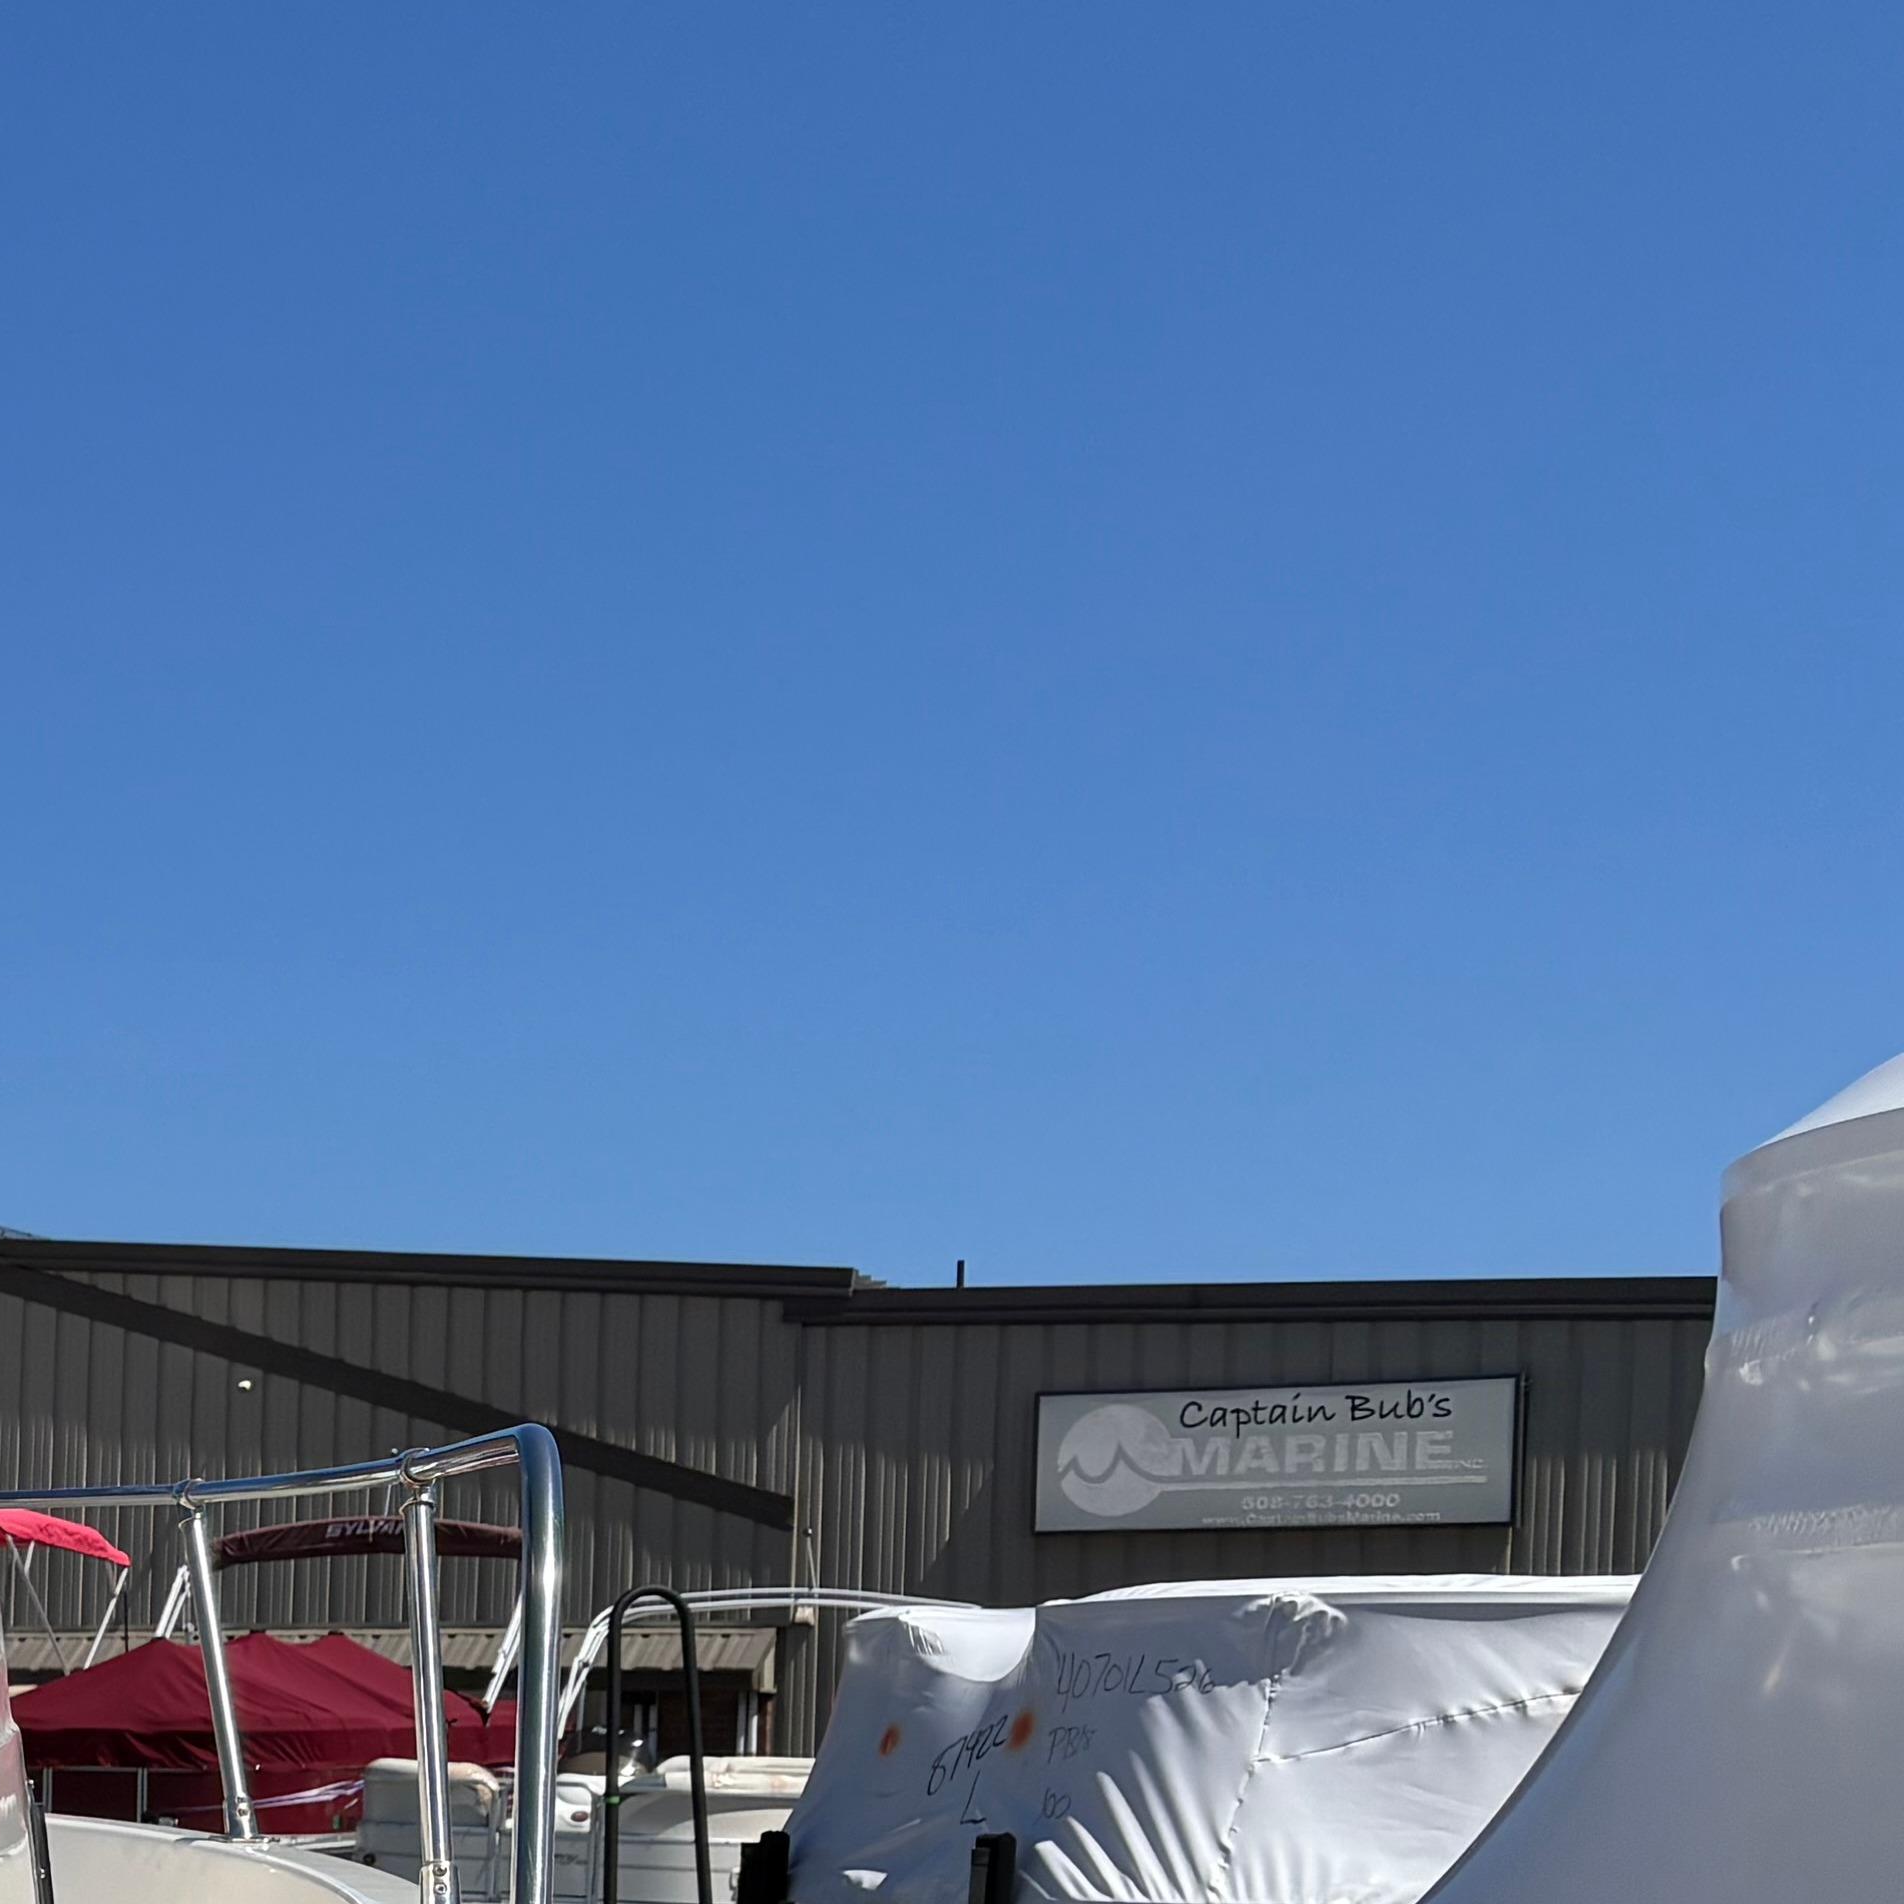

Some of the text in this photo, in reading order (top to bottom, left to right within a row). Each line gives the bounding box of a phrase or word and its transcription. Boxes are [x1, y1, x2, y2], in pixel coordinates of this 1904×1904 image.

[1179, 1390, 1453, 1439] Captain Bub's
[1172, 1430, 1454, 1476] MARINE
